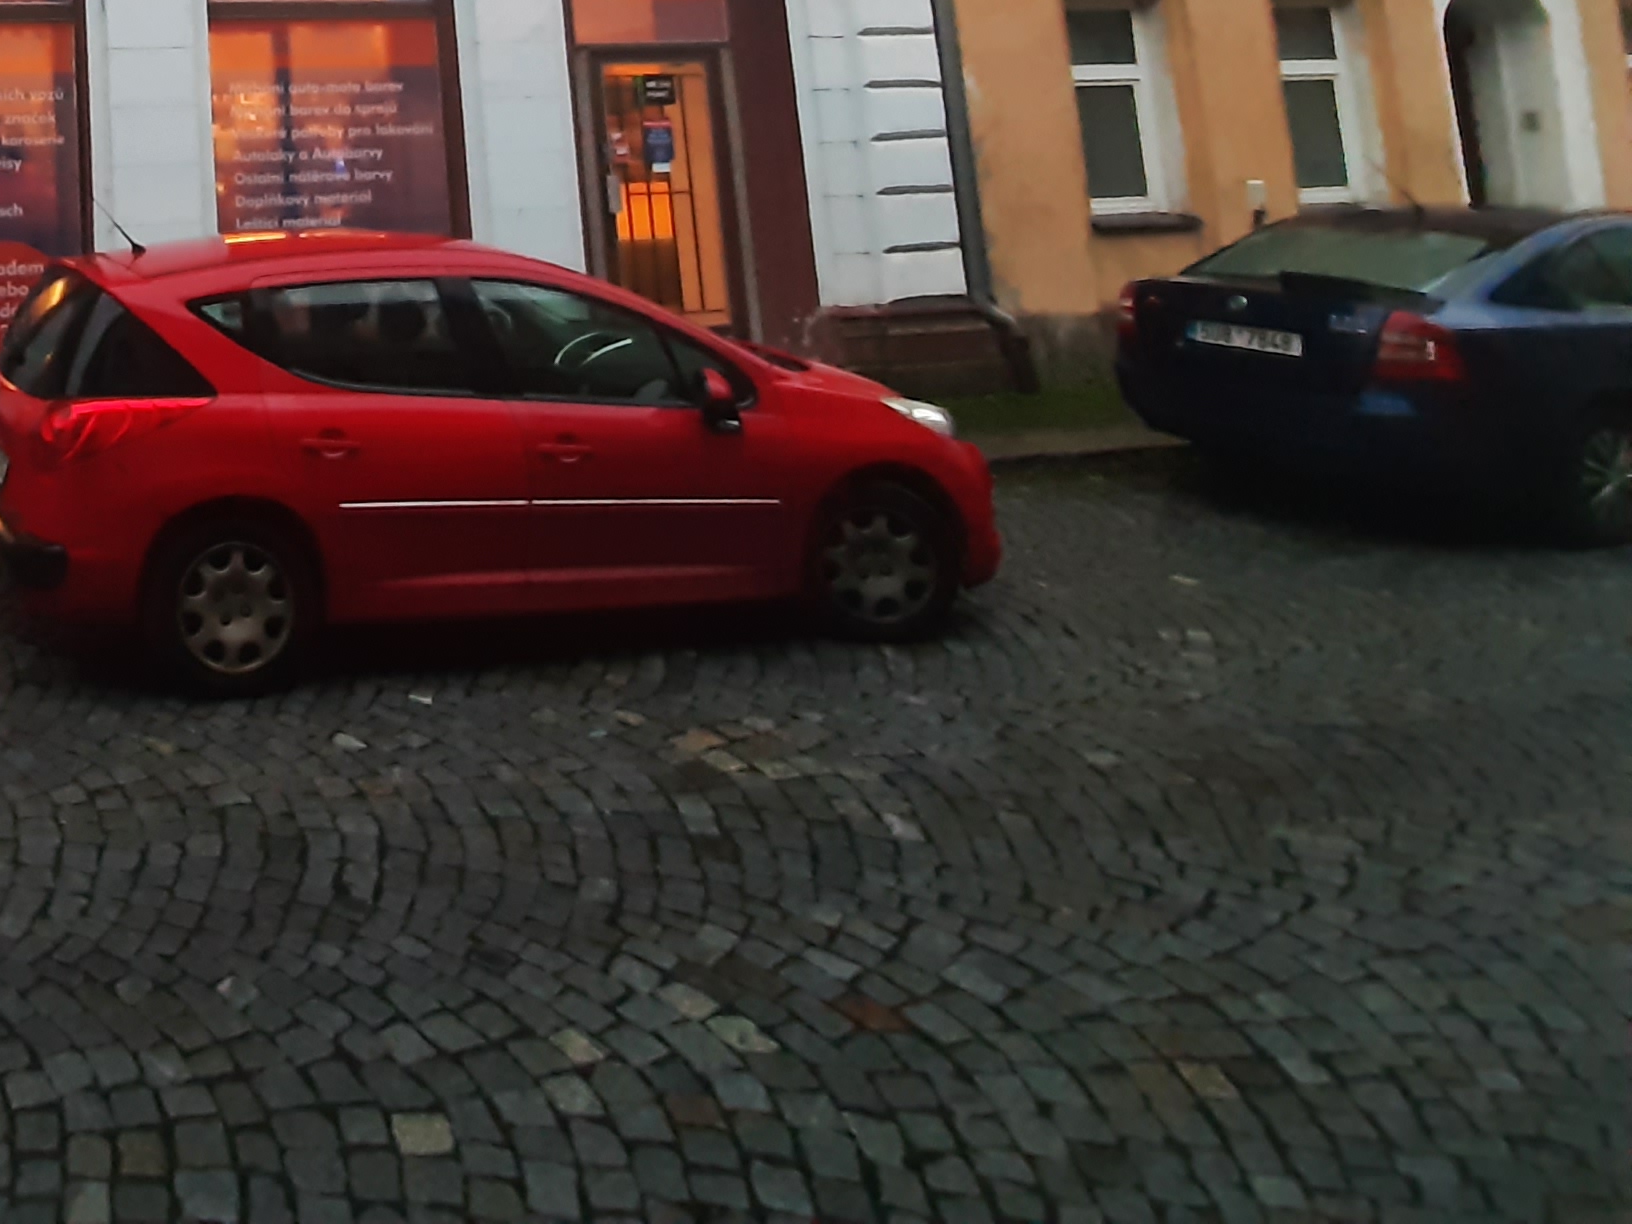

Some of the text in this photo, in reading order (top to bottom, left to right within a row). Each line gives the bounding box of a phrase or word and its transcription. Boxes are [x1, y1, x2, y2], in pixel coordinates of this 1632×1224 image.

[334, 103, 351, 116] do
[348, 126, 371, 139] pro
[354, 167, 394, 183] barvy
